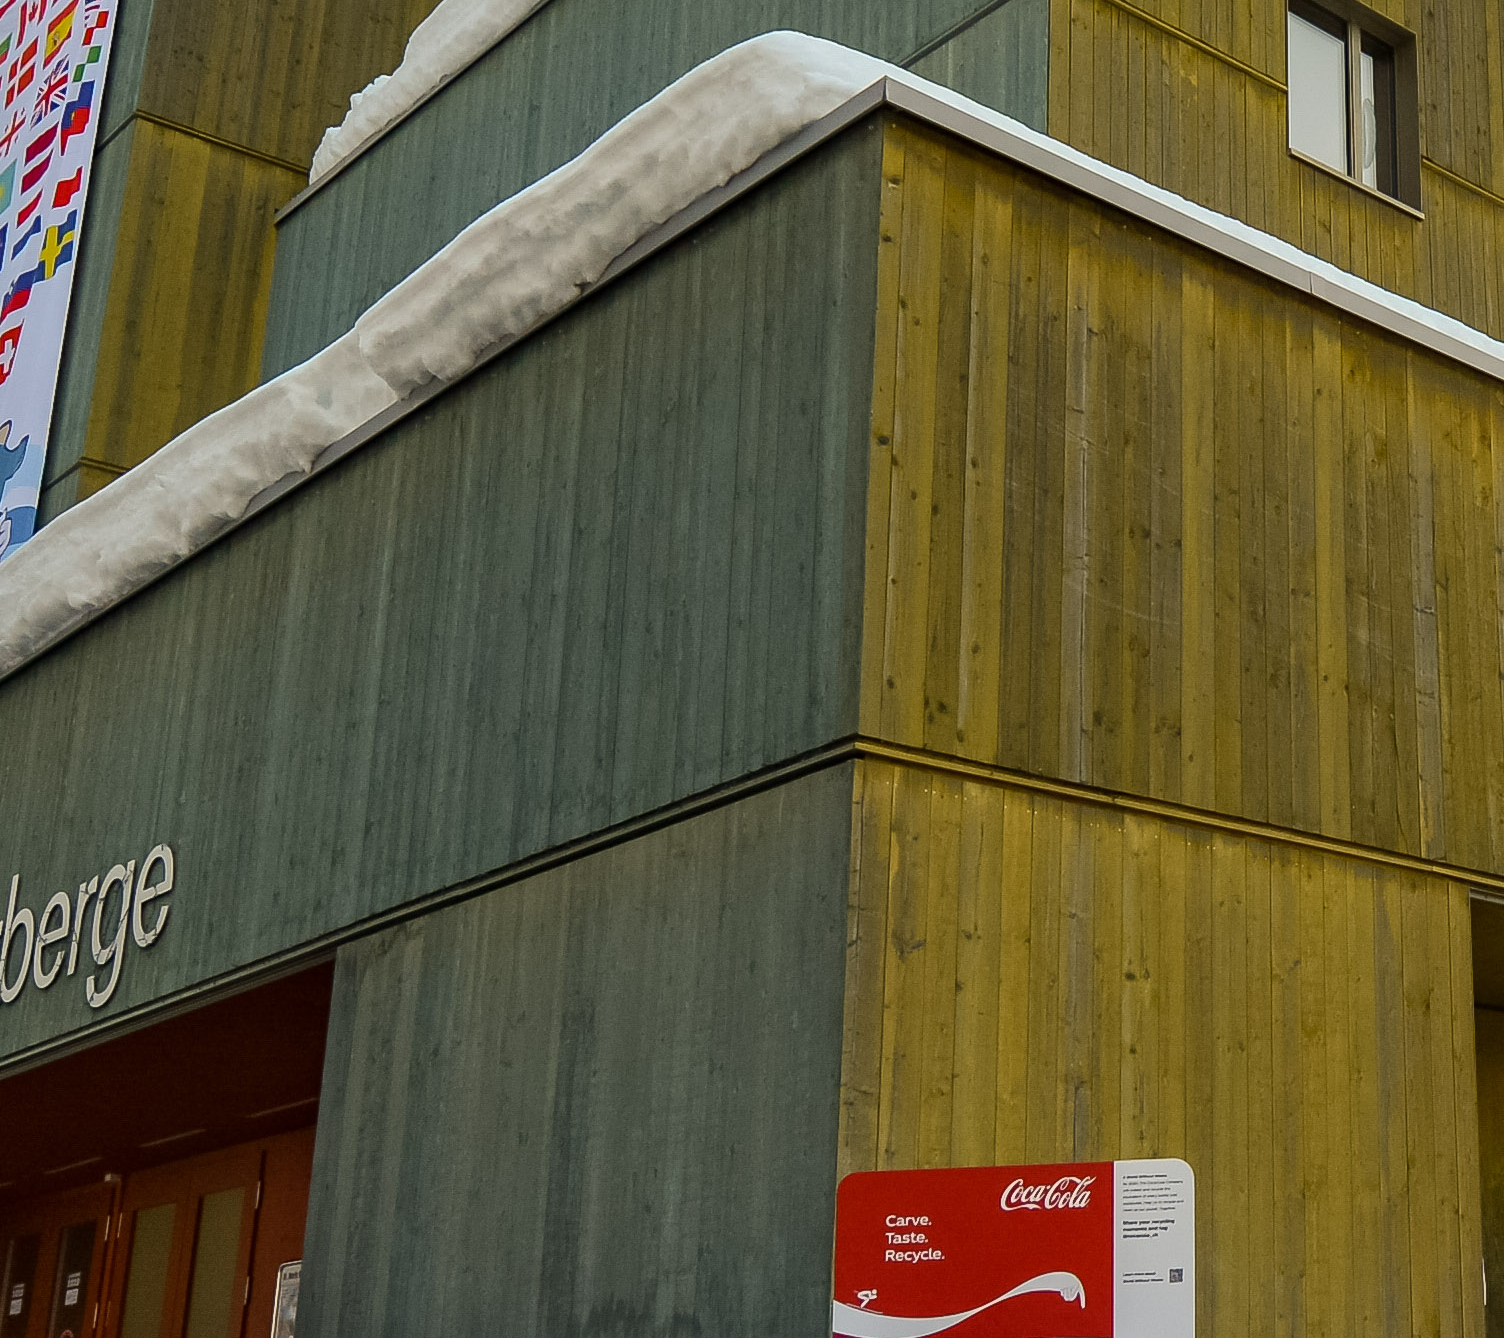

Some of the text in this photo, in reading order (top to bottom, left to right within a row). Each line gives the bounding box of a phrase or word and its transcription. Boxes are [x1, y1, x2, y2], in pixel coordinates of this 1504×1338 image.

[885, 1214, 932, 1228] Carve.
[885, 1231, 929, 1245] Taste.
[885, 1247, 945, 1264] Recycle.
